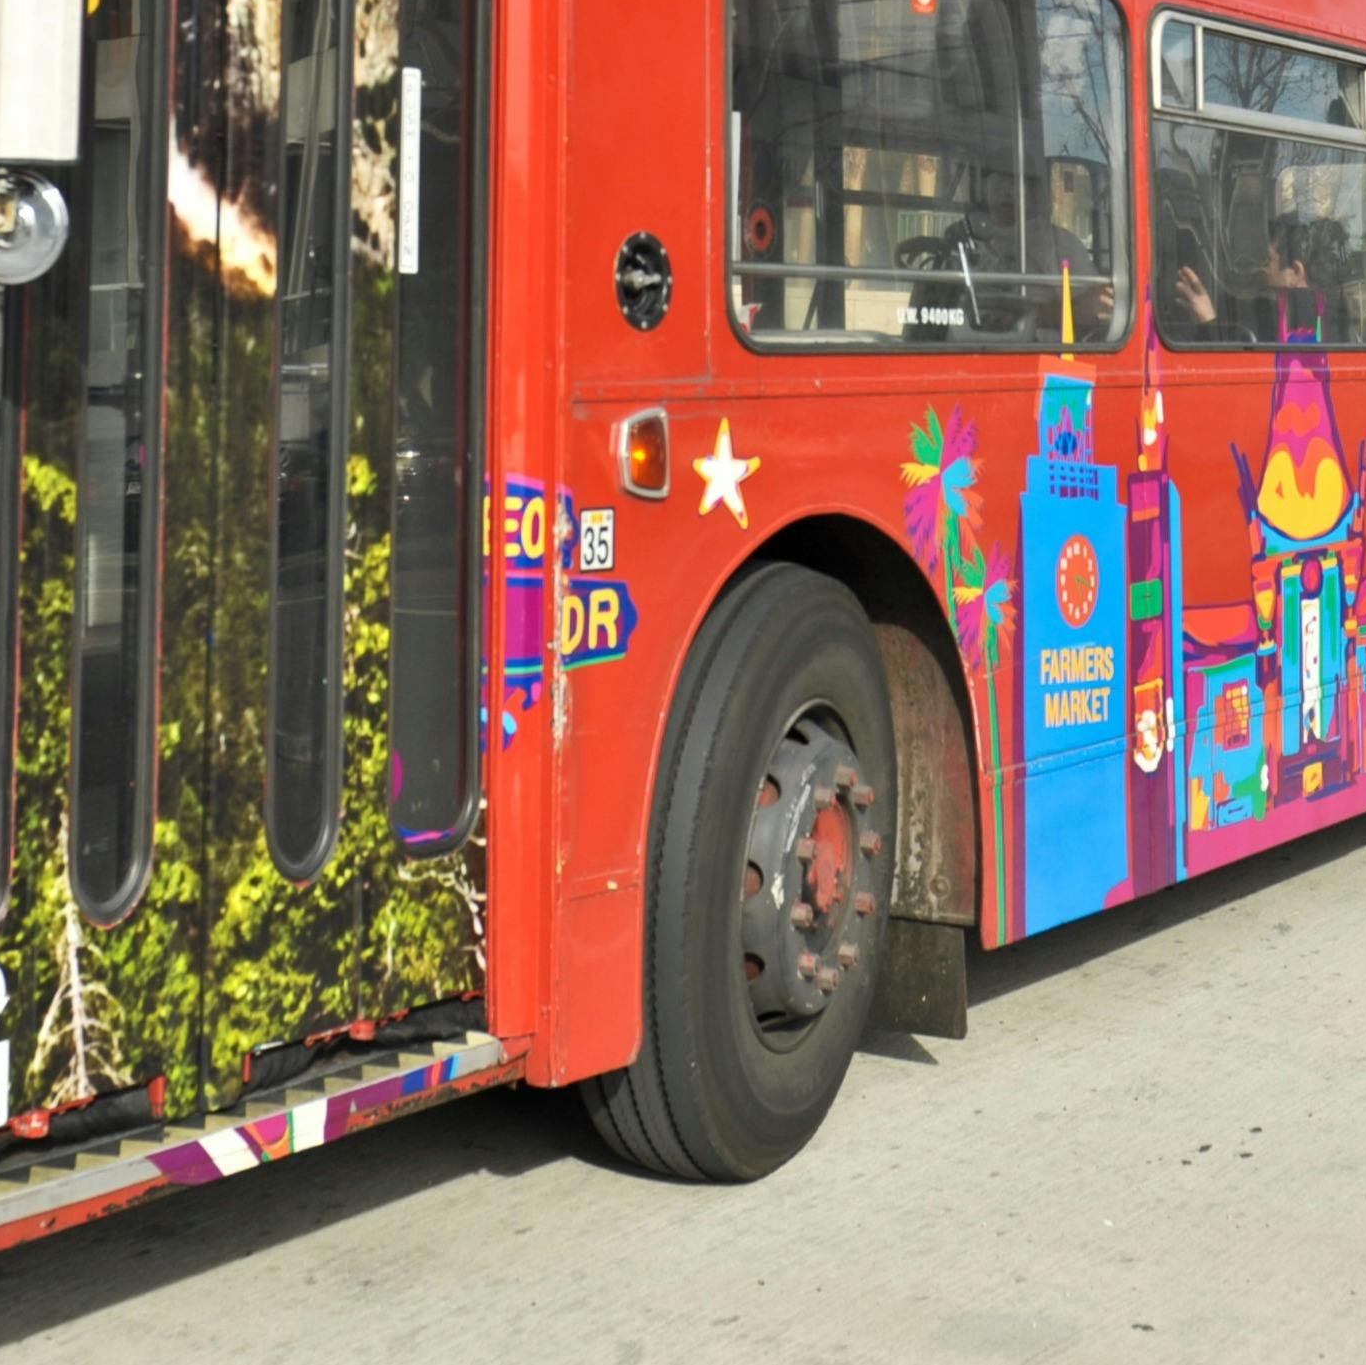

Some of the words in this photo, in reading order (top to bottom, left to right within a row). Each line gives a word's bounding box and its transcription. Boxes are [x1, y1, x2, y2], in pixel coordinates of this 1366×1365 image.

[583, 526, 610, 566] 35
[561, 588, 620, 655] DR
[1039, 646, 1115, 685] FARMERS
[1044, 687, 1111, 728] MARKET
